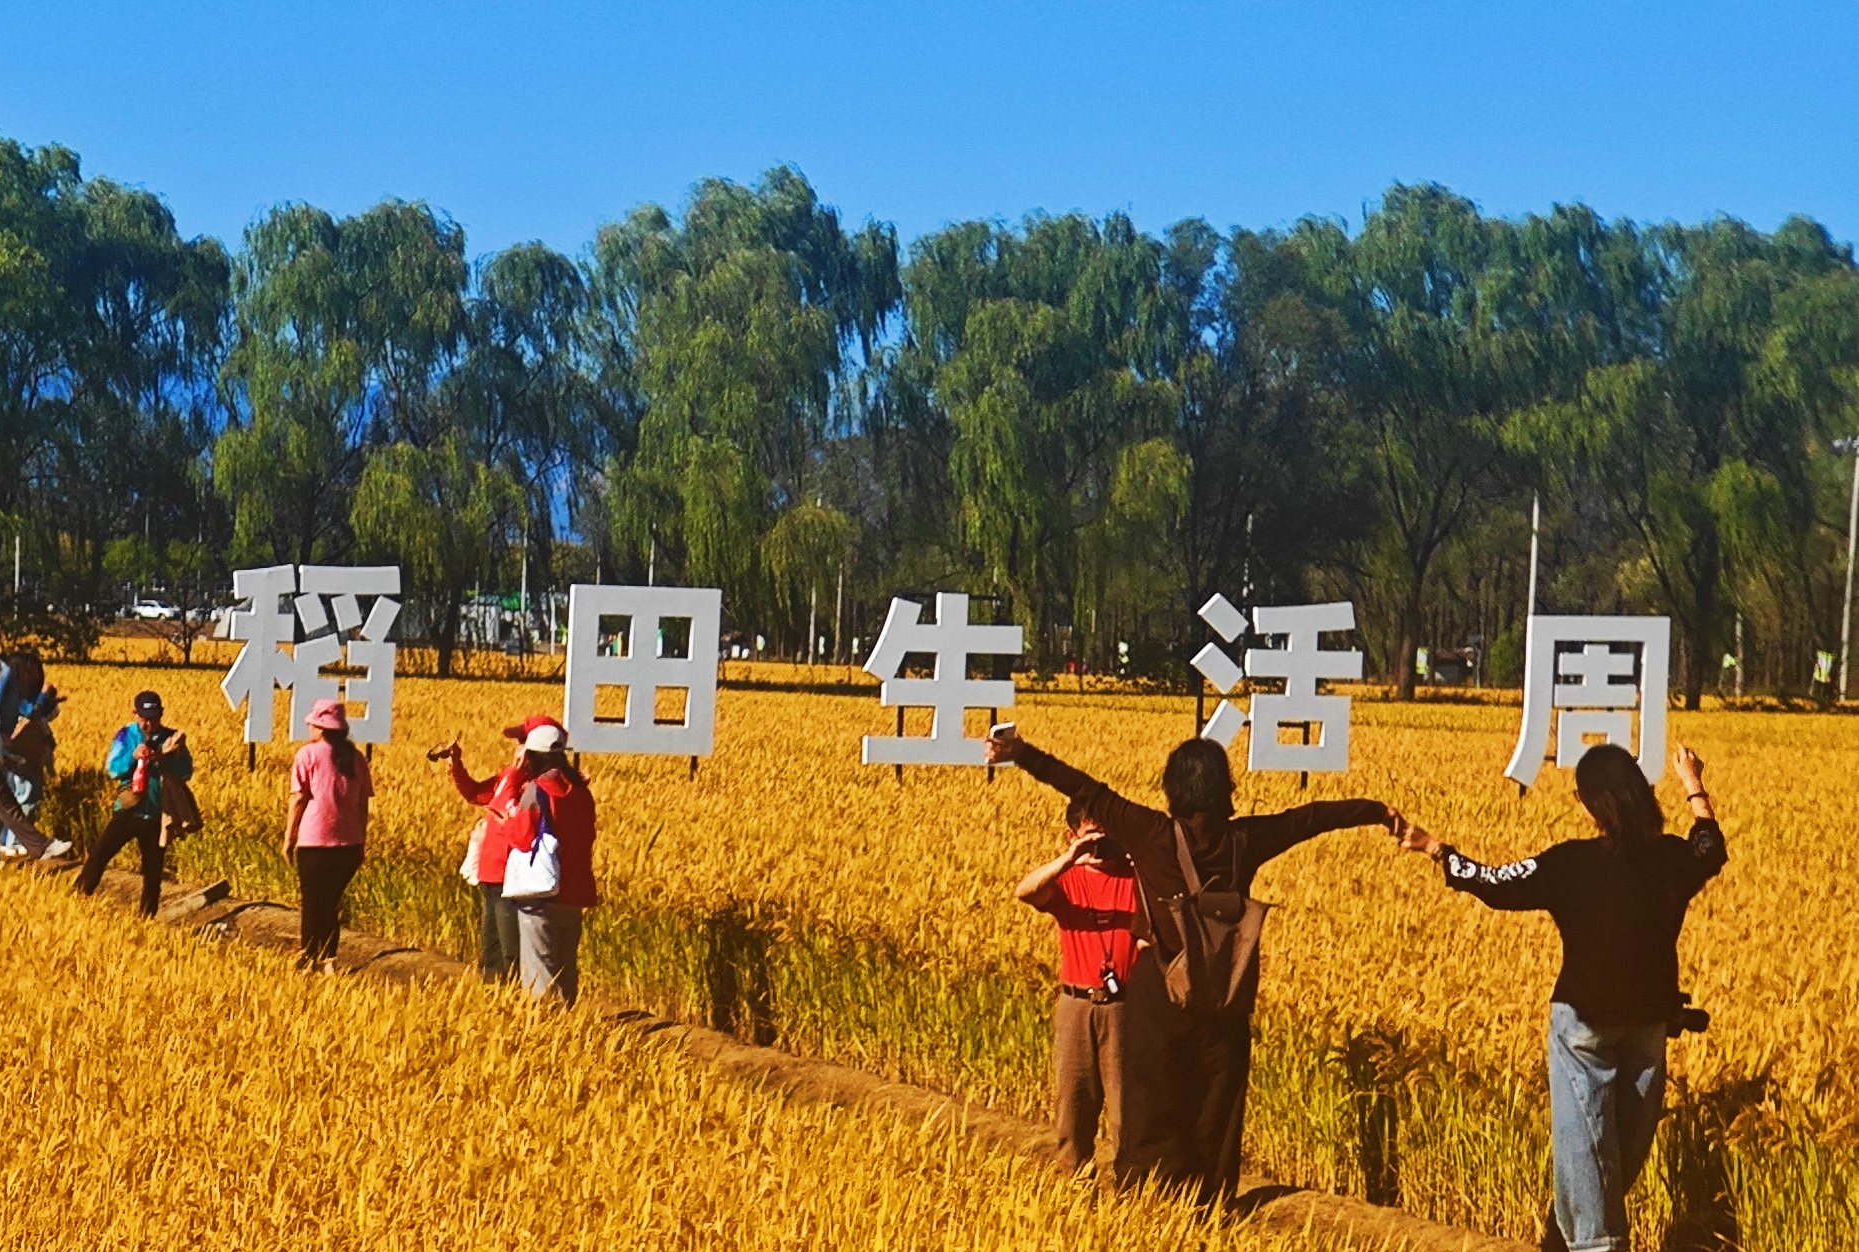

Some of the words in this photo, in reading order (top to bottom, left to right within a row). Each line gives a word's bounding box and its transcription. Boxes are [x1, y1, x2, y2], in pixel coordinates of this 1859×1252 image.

[221, 564, 1670, 787] 稻田生活周
